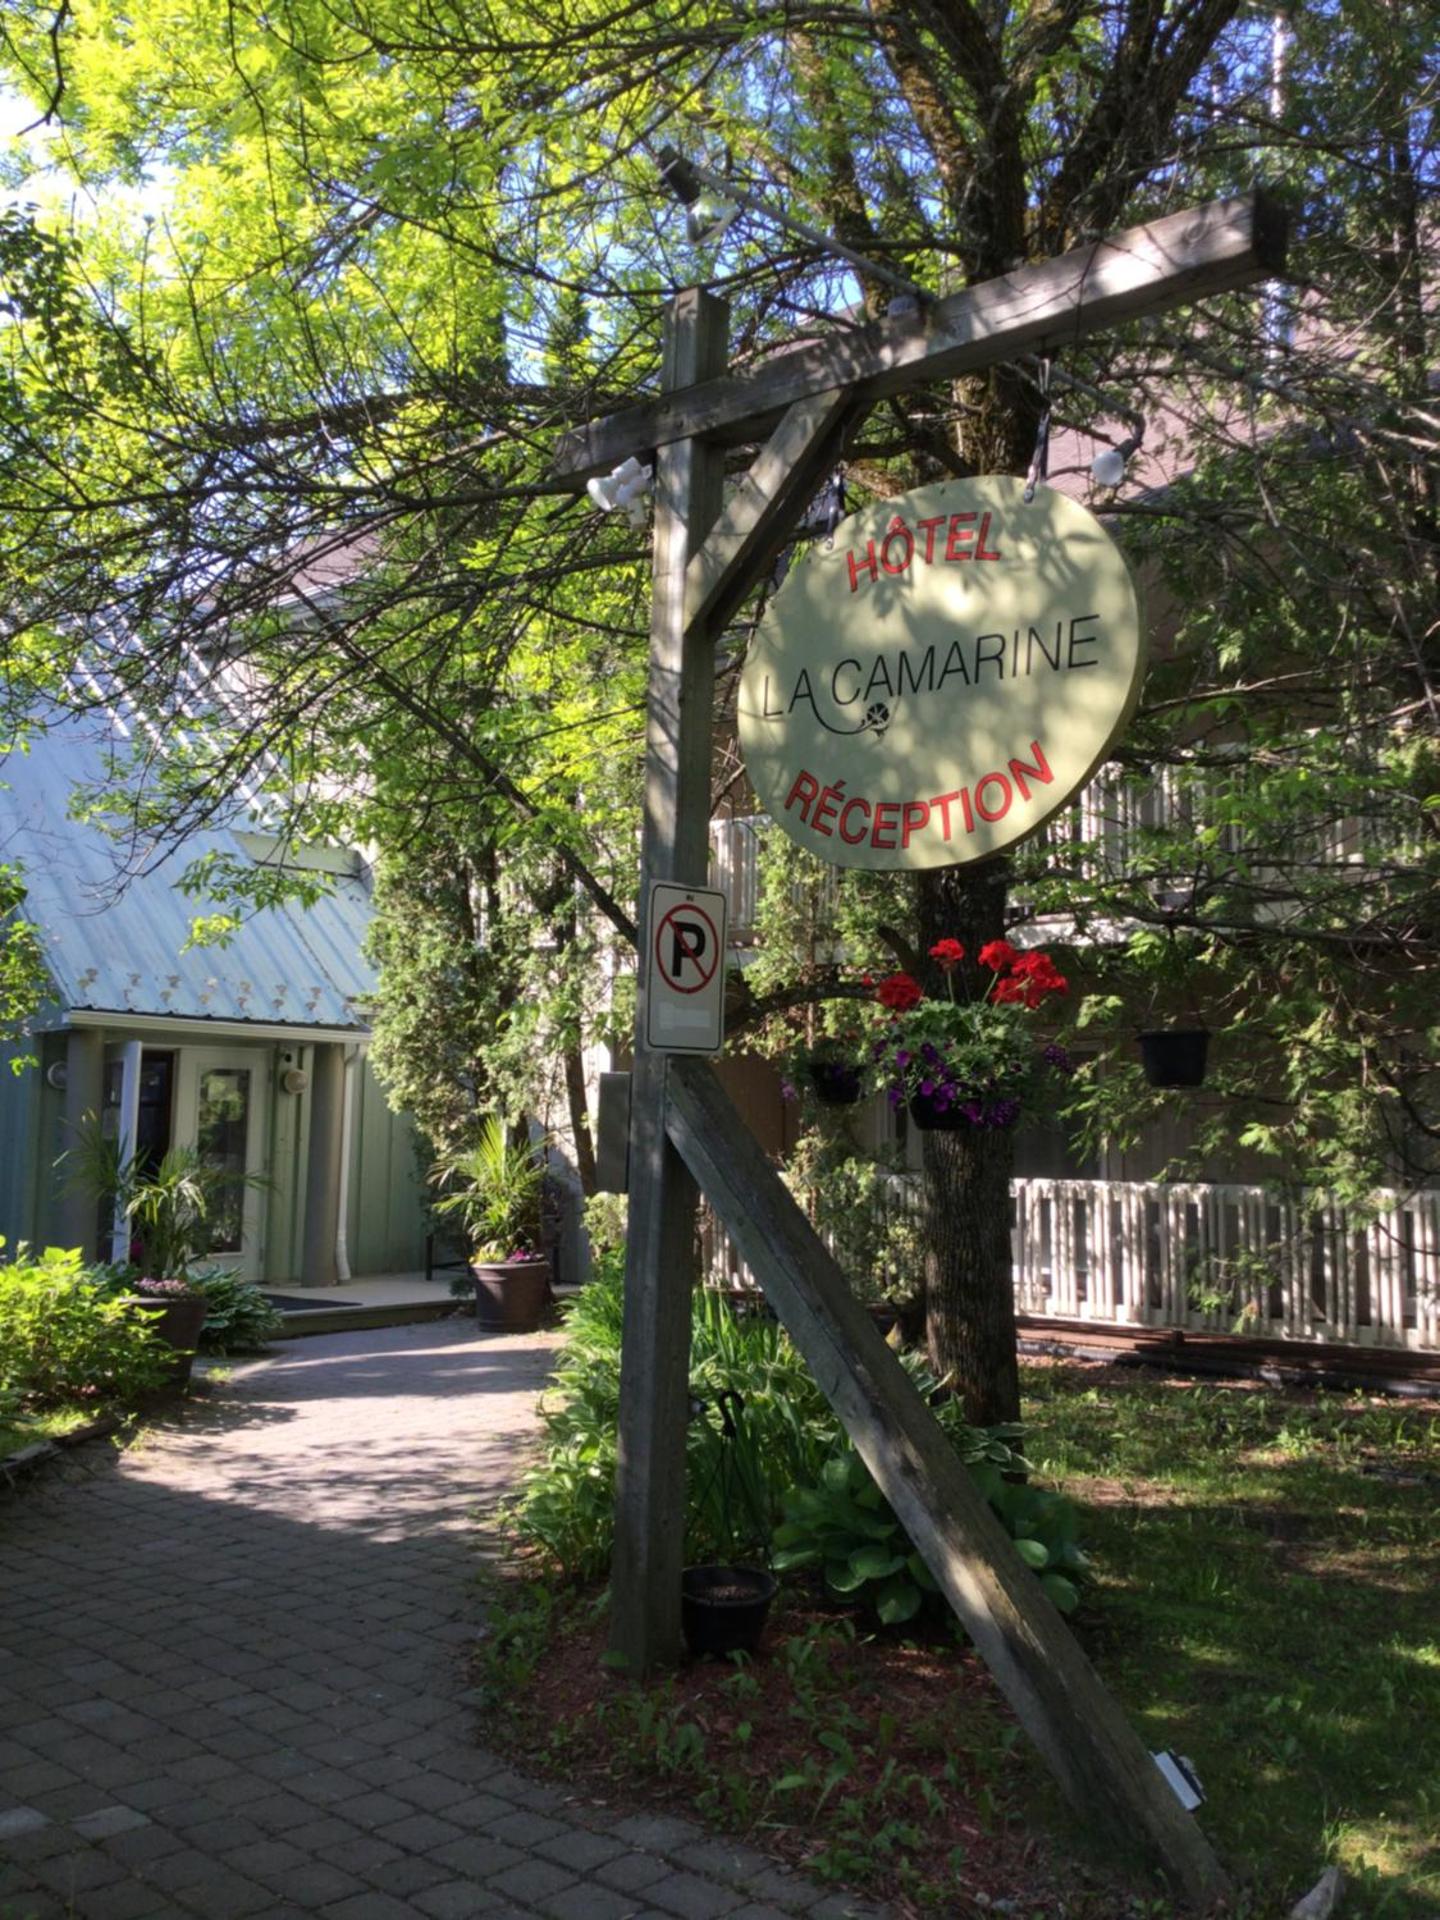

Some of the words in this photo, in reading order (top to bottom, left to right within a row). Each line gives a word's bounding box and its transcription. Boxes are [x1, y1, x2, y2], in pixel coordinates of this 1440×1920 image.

[847, 511, 1000, 592] HÔTEL
[831, 614, 1100, 706] CAMARINE
[784, 740, 1055, 850] RÉCEPTION
[671, 921, 706, 977] P
